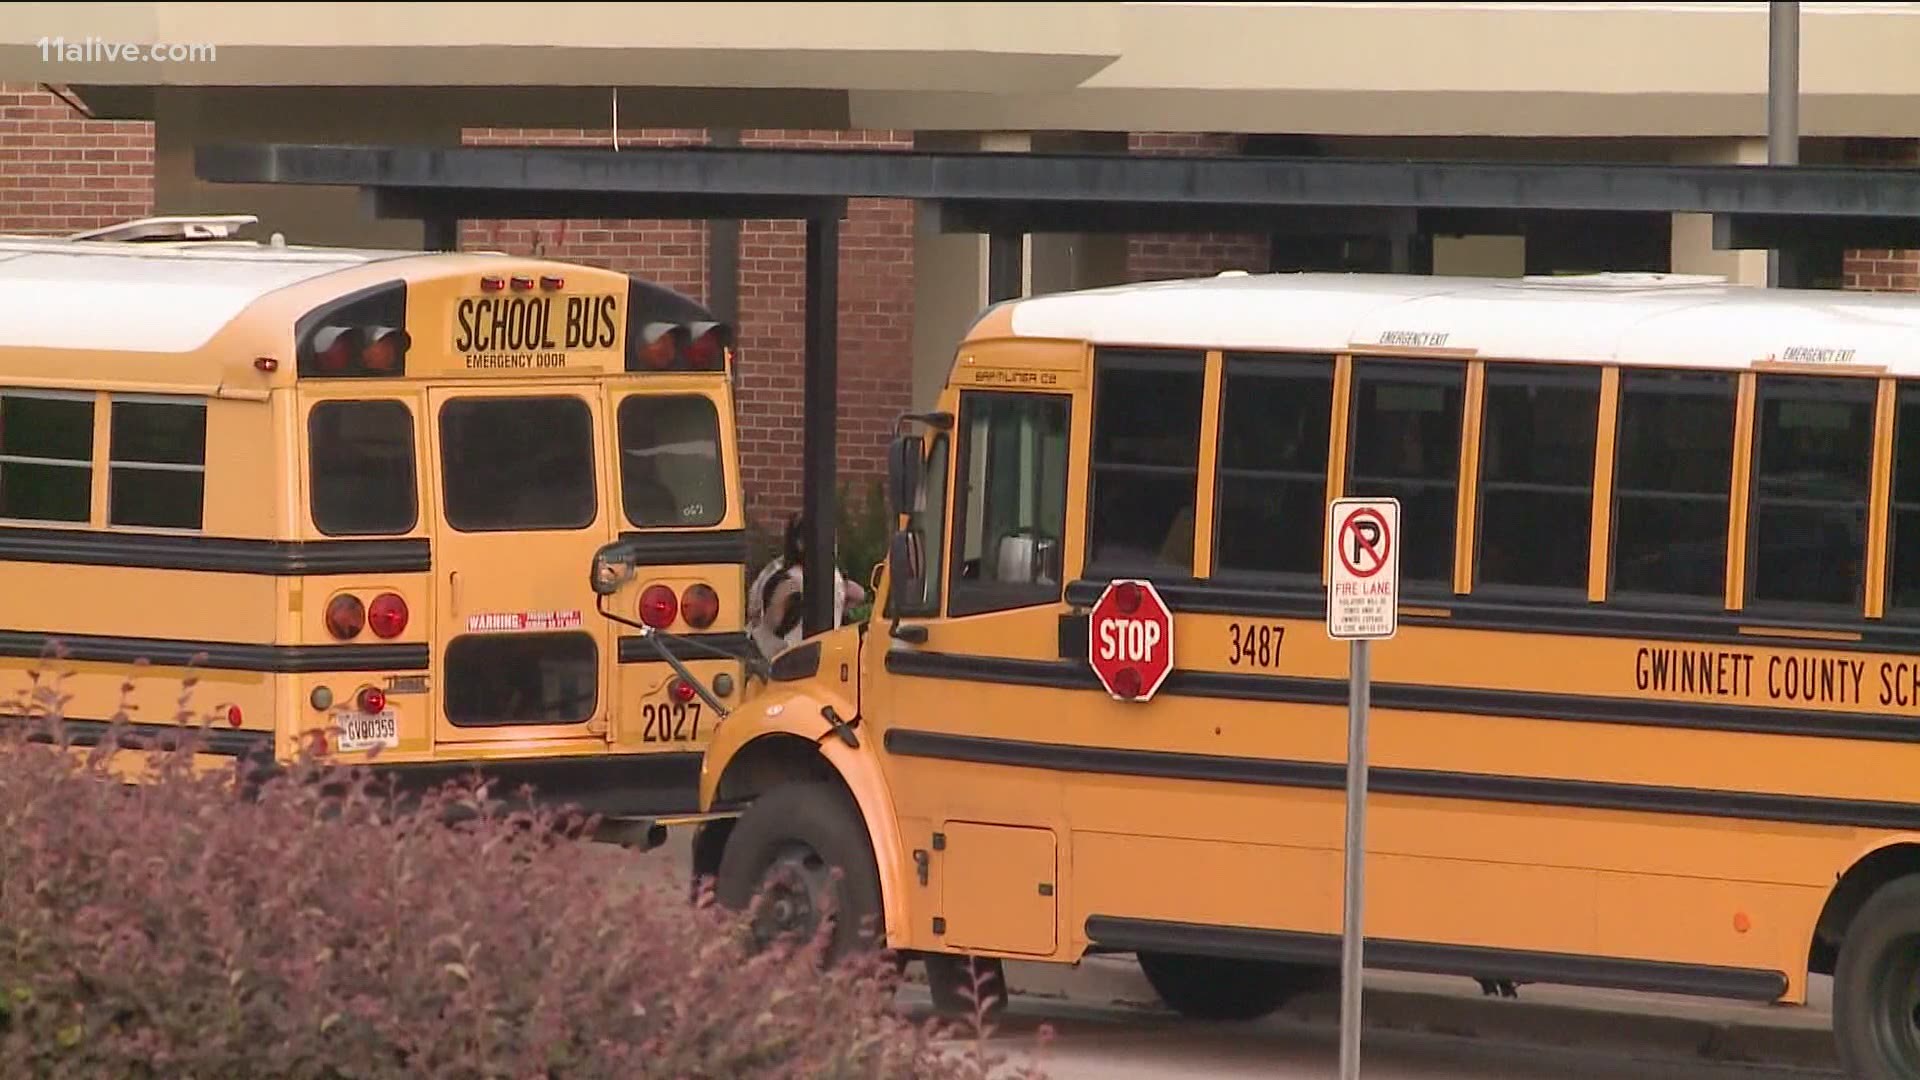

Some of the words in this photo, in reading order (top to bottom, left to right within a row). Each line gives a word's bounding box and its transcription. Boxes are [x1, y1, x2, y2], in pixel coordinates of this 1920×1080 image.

[456, 297, 556, 352] SCHOOL
[565, 295, 617, 349] BUS
[465, 354, 534, 368] EMERGENCY
[536, 353, 566, 367] DOOR
[1335, 583, 1359, 596] FIRE
[1362, 582, 1391, 595] LANE
[1100, 618, 1161, 663] STOP
[1229, 623, 1285, 668] 3487
[1635, 647, 1754, 698] GWINNETT
[1768, 655, 1865, 704] COUNTY
[642, 703, 702, 742] 2027
